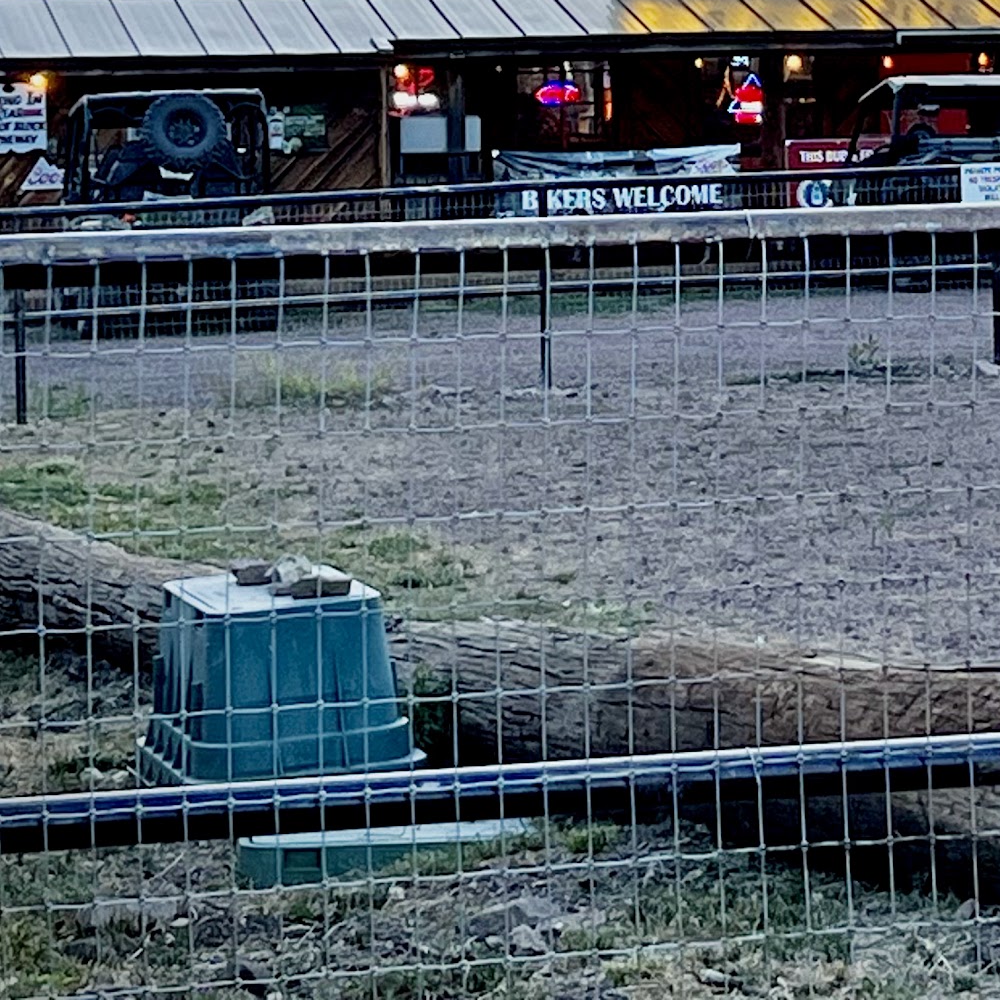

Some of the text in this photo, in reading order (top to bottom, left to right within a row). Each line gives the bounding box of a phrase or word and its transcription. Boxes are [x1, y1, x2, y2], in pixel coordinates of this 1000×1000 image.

[799, 150, 824, 163] THIS
[521, 183, 724, 211] BKERS WELCOME
